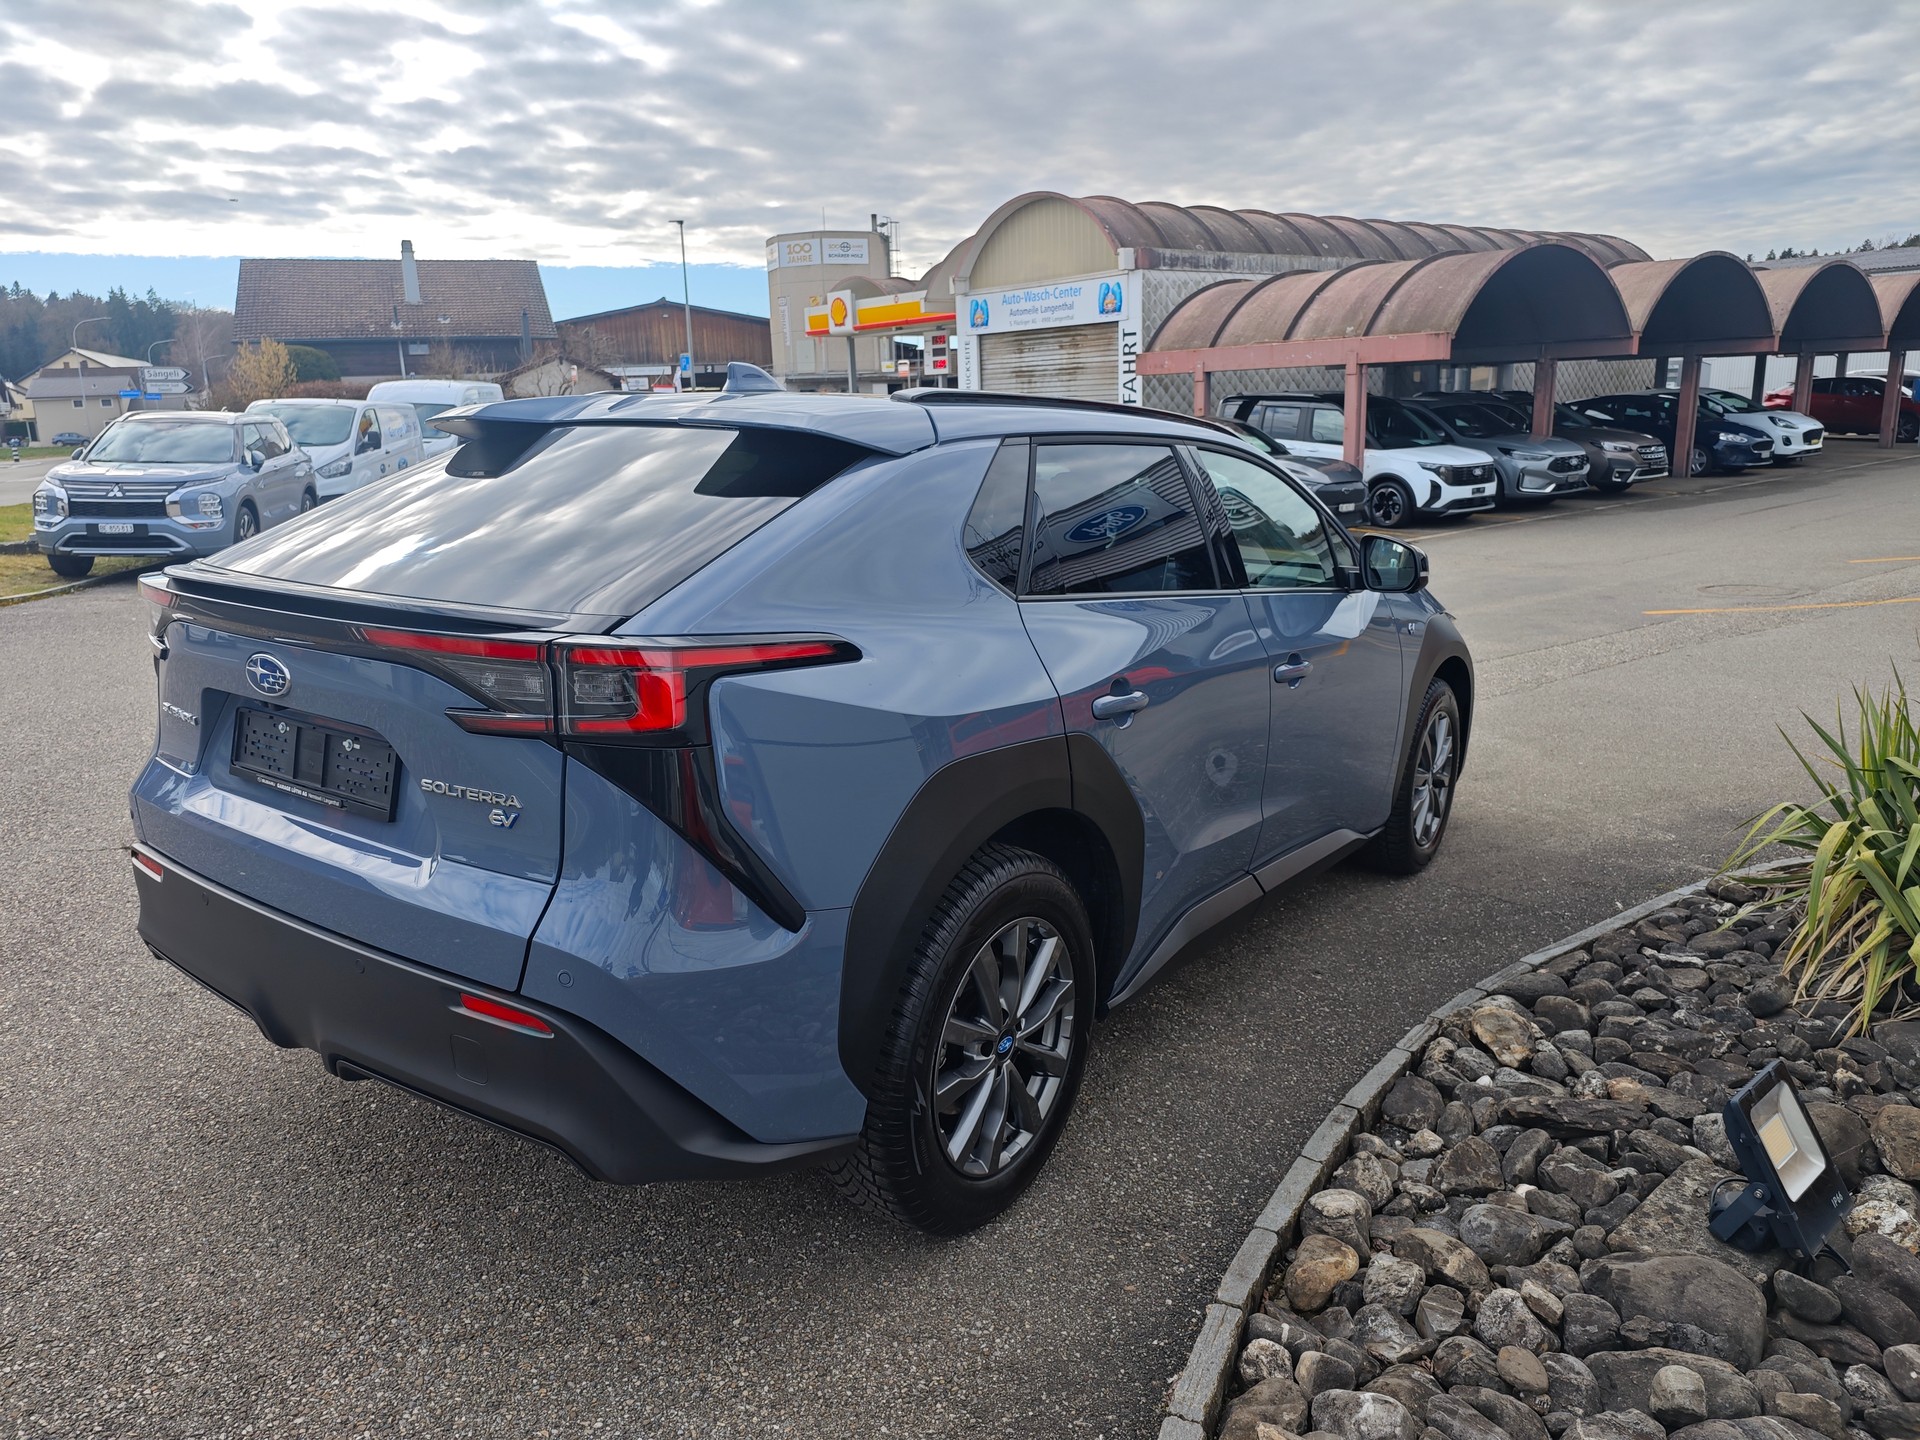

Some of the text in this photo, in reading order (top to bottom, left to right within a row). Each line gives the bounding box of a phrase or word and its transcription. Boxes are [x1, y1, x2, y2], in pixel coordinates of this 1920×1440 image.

[786, 243, 812, 255] 100
[787, 255, 813, 264] JAHRE
[1002, 287, 1082, 305] Auto-Wasch-Center
[1009, 301, 1075, 317] Automeile Langenthal
[706, 365, 713, 373] 2
[1122, 328, 1137, 404] FAHRT
[420, 778, 523, 809] SOLTERRA
[488, 808, 519, 829] EV
[1831, 1191, 1843, 1208] IP66
